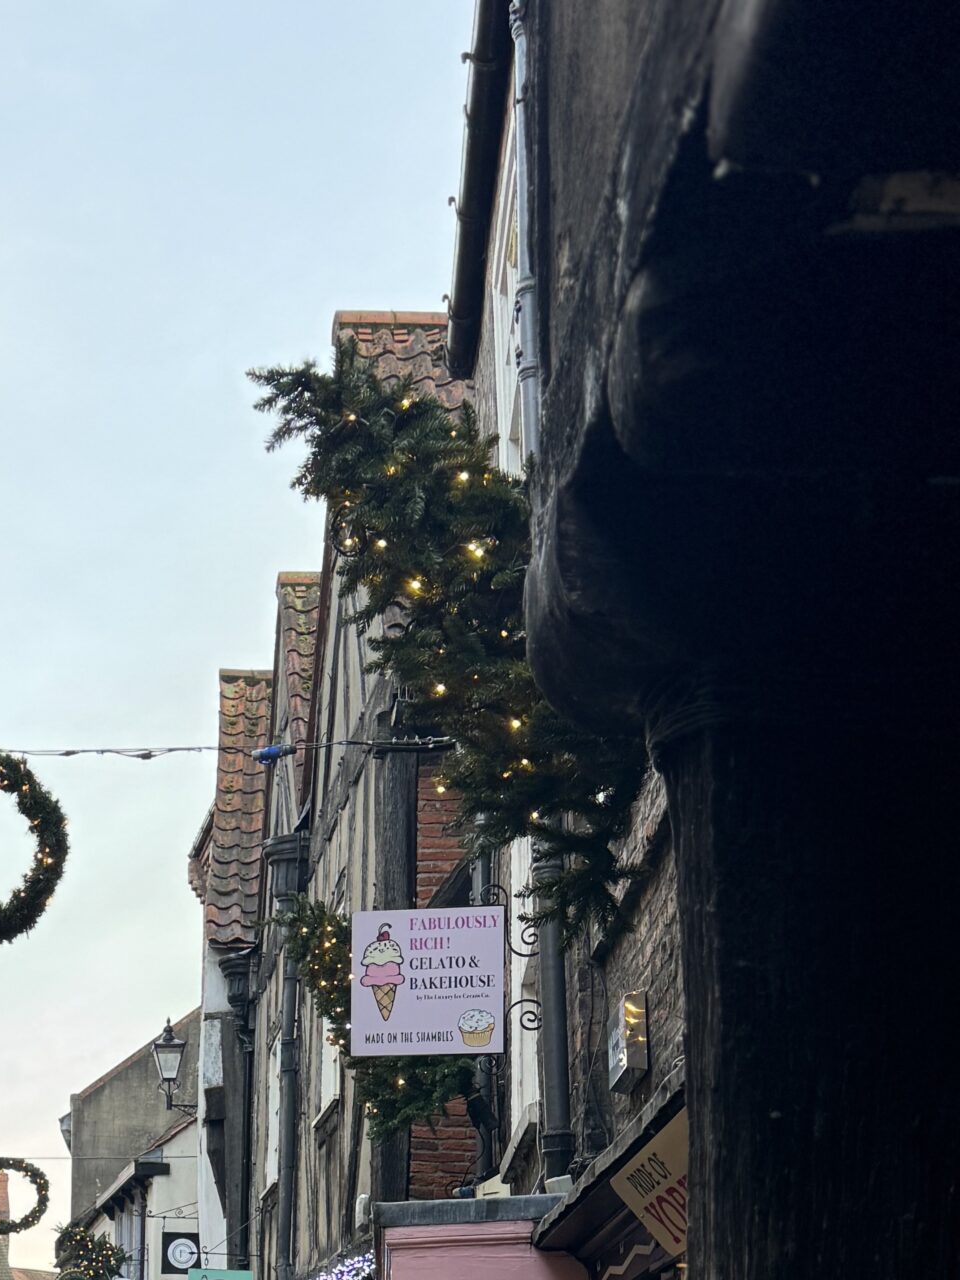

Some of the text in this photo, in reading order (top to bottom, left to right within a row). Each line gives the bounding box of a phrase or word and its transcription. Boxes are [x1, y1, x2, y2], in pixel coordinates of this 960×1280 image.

[410, 915, 500, 931] FABULOUSLY
[409, 955, 480, 971] GELATO &
[409, 974, 496, 990] BAKEHOUSE
[365, 1031, 454, 1044] MADE ON THE SHAMBLES
[626, 1152, 672, 1199] PRIDE OF
[643, 1173, 688, 1244] YOR
